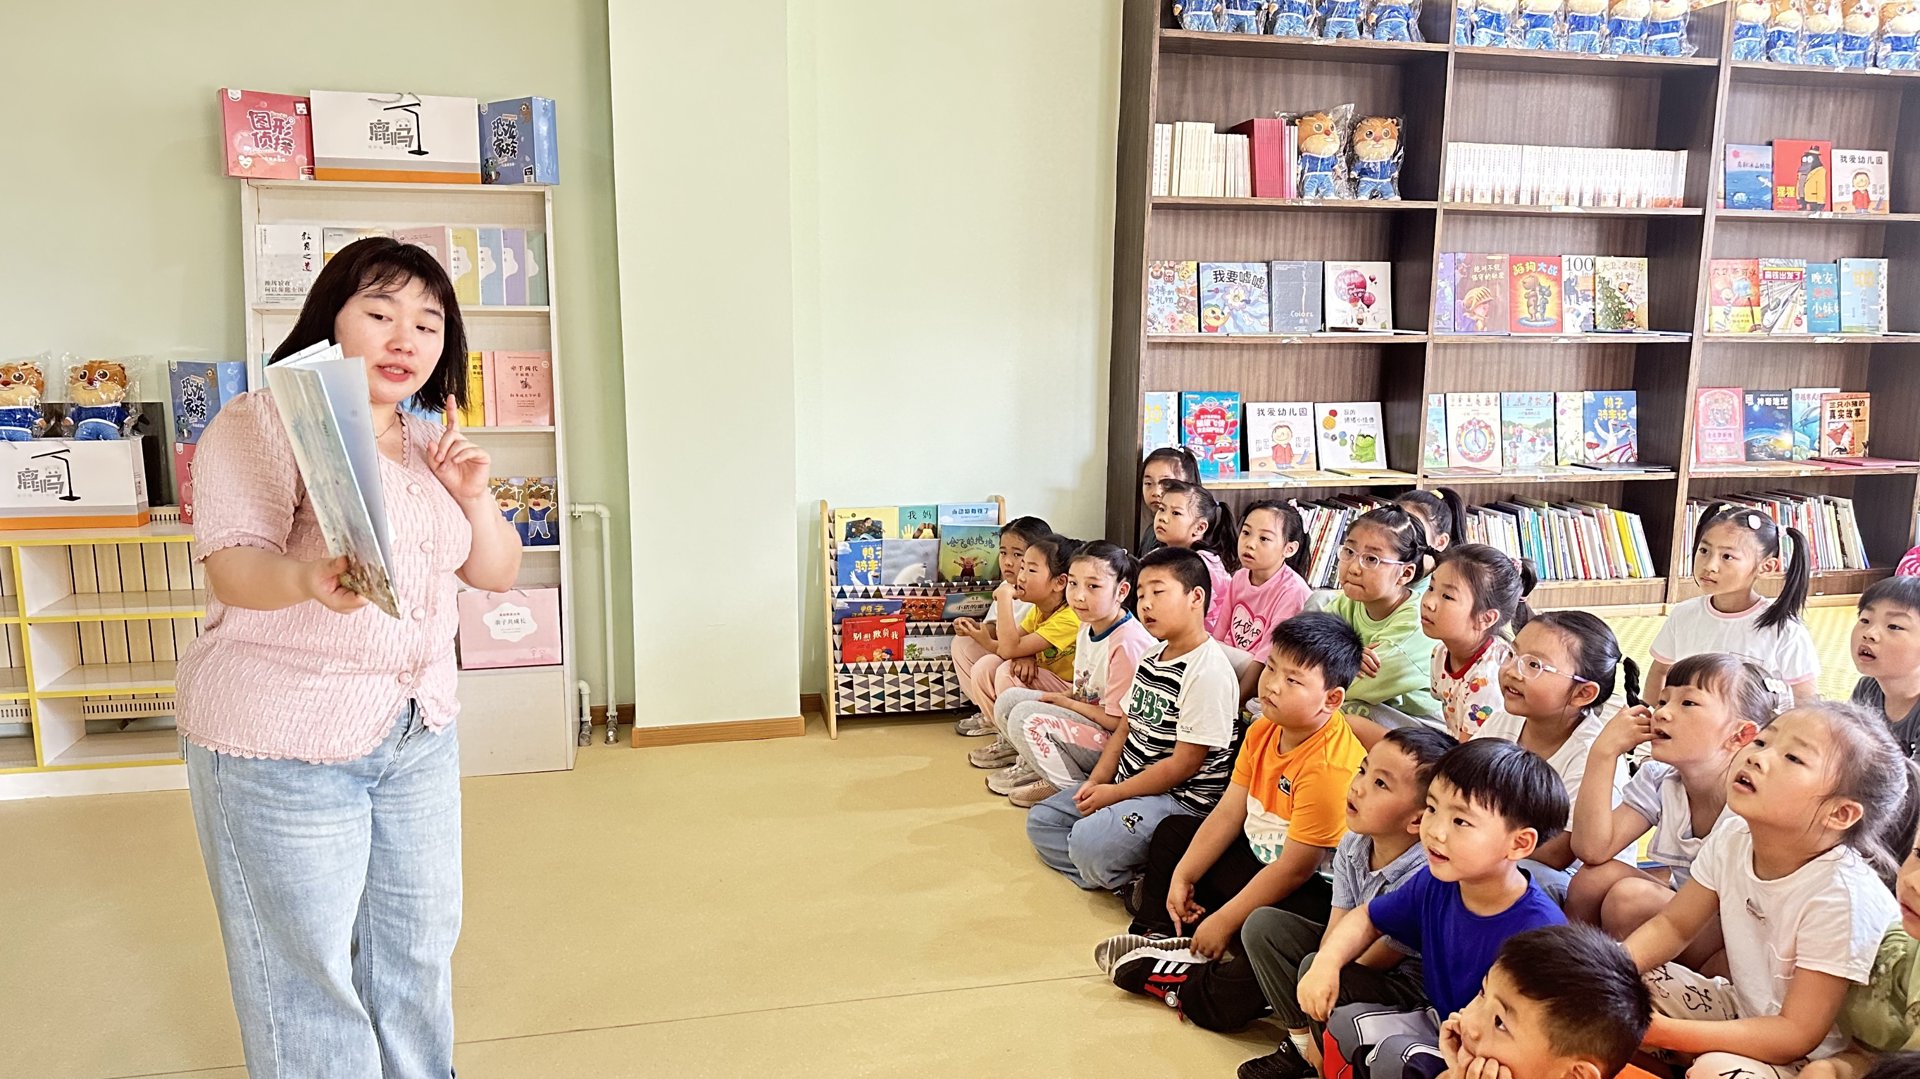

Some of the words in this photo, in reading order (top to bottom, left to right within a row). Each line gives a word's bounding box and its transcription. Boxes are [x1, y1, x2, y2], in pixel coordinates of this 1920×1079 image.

[247, 110, 293, 136] 图形
[492, 116, 517, 140] 恐龙
[251, 131, 294, 155] 侦探
[492, 137, 518, 158] 家族
[1840, 155, 1884, 165] 我爱幼儿园
[1512, 261, 1559, 276] 猫狗大战
[1564, 257, 1594, 272] 100
[1212, 269, 1265, 289] 我要嘘嘘
[181, 377, 205, 401] 恐龙
[184, 396, 206, 420] 家族
[1257, 407, 1308, 417] 我爱幼儿园
[1829, 400, 1866, 409] 三只小猪的
[1829, 408, 1861, 419] 真实故事
[855, 560, 881, 572] 骑车
[853, 628, 899, 641] 别想欺负我
